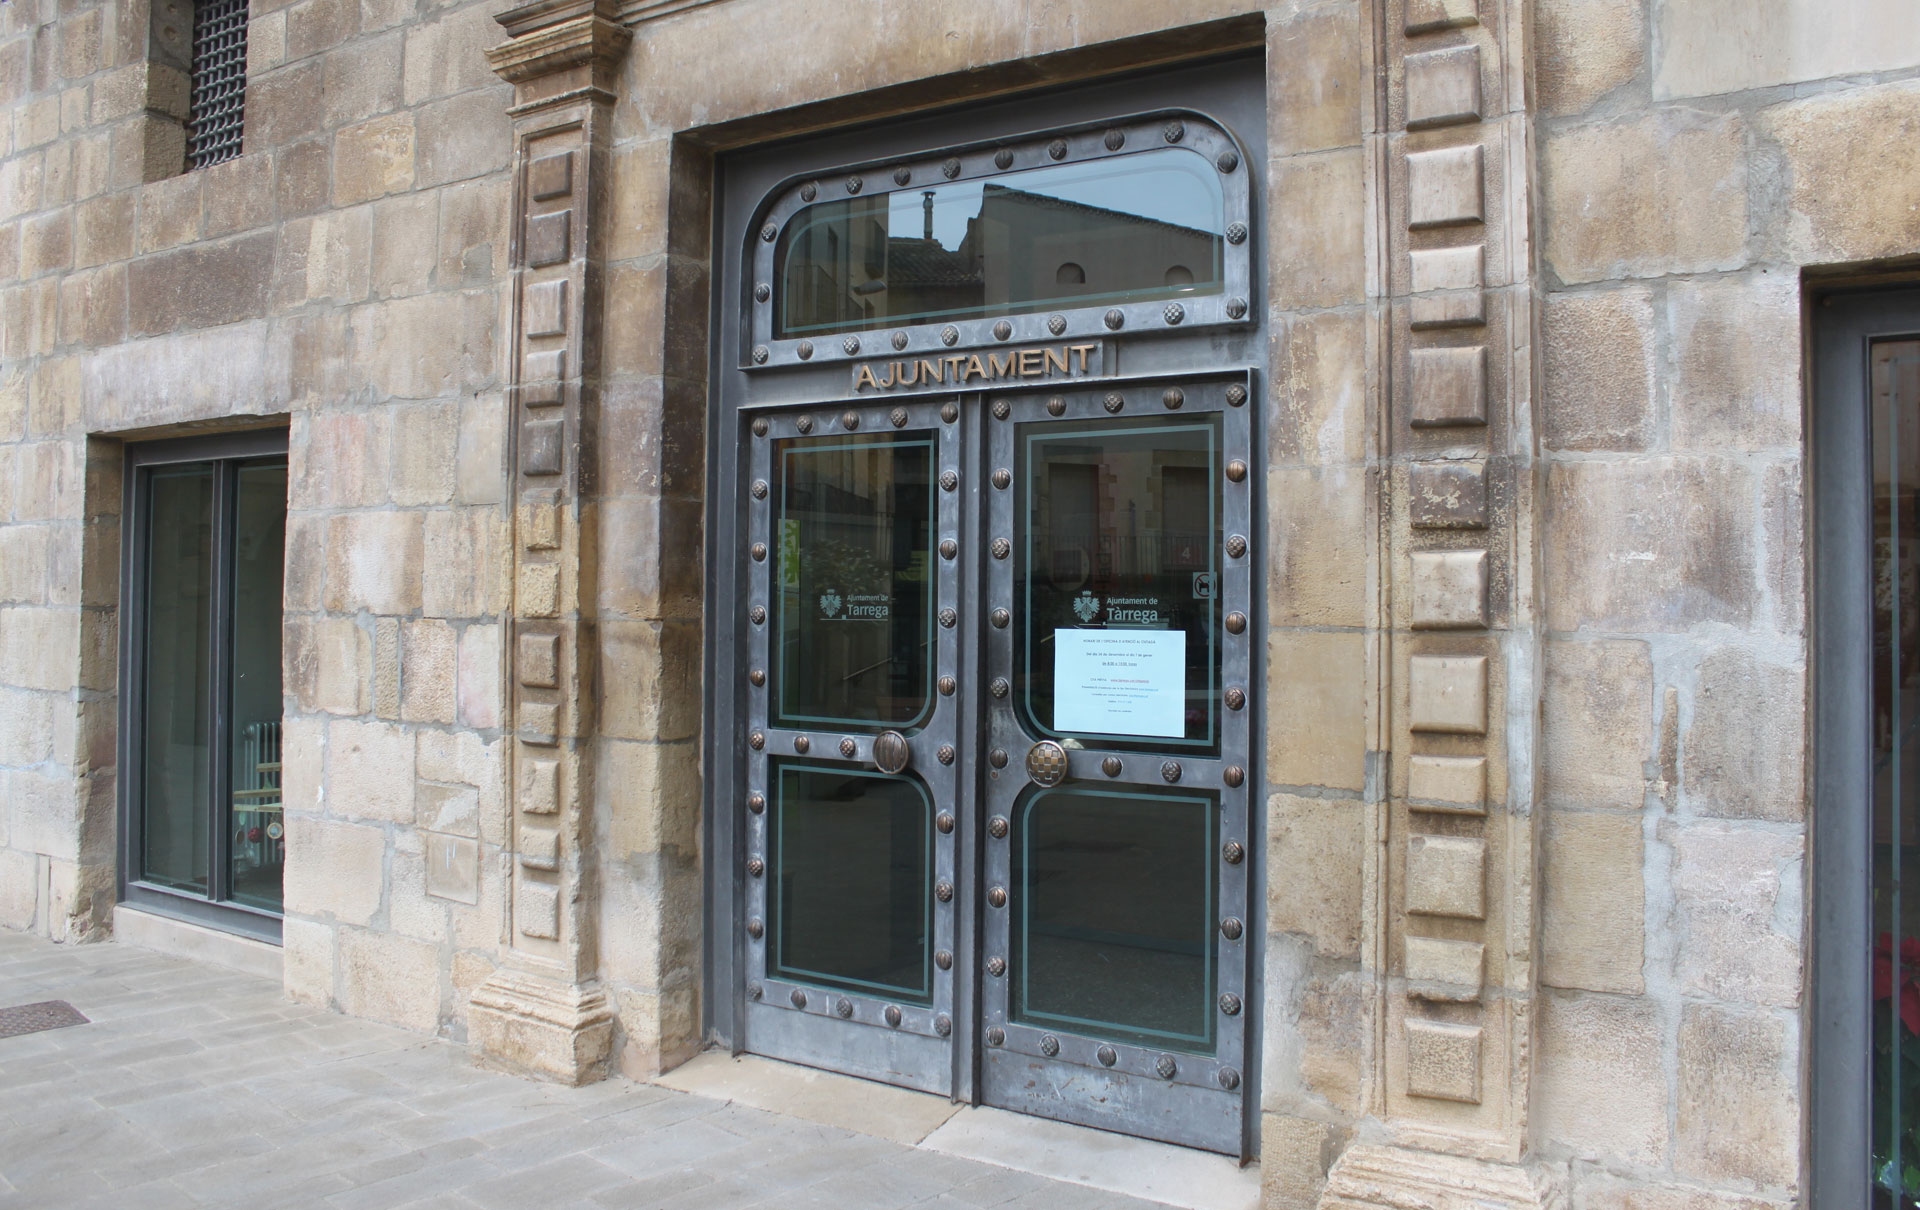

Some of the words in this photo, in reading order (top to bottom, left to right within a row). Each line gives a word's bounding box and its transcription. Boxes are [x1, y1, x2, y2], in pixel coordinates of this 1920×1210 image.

[855, 344, 1096, 391] AJUNTAMENT
[847, 594, 880, 602] Ajuntament
[1106, 596, 1147, 606] Ajuntament
[1148, 597, 1158, 605] de
[1106, 606, 1158, 624] Tàrrega
